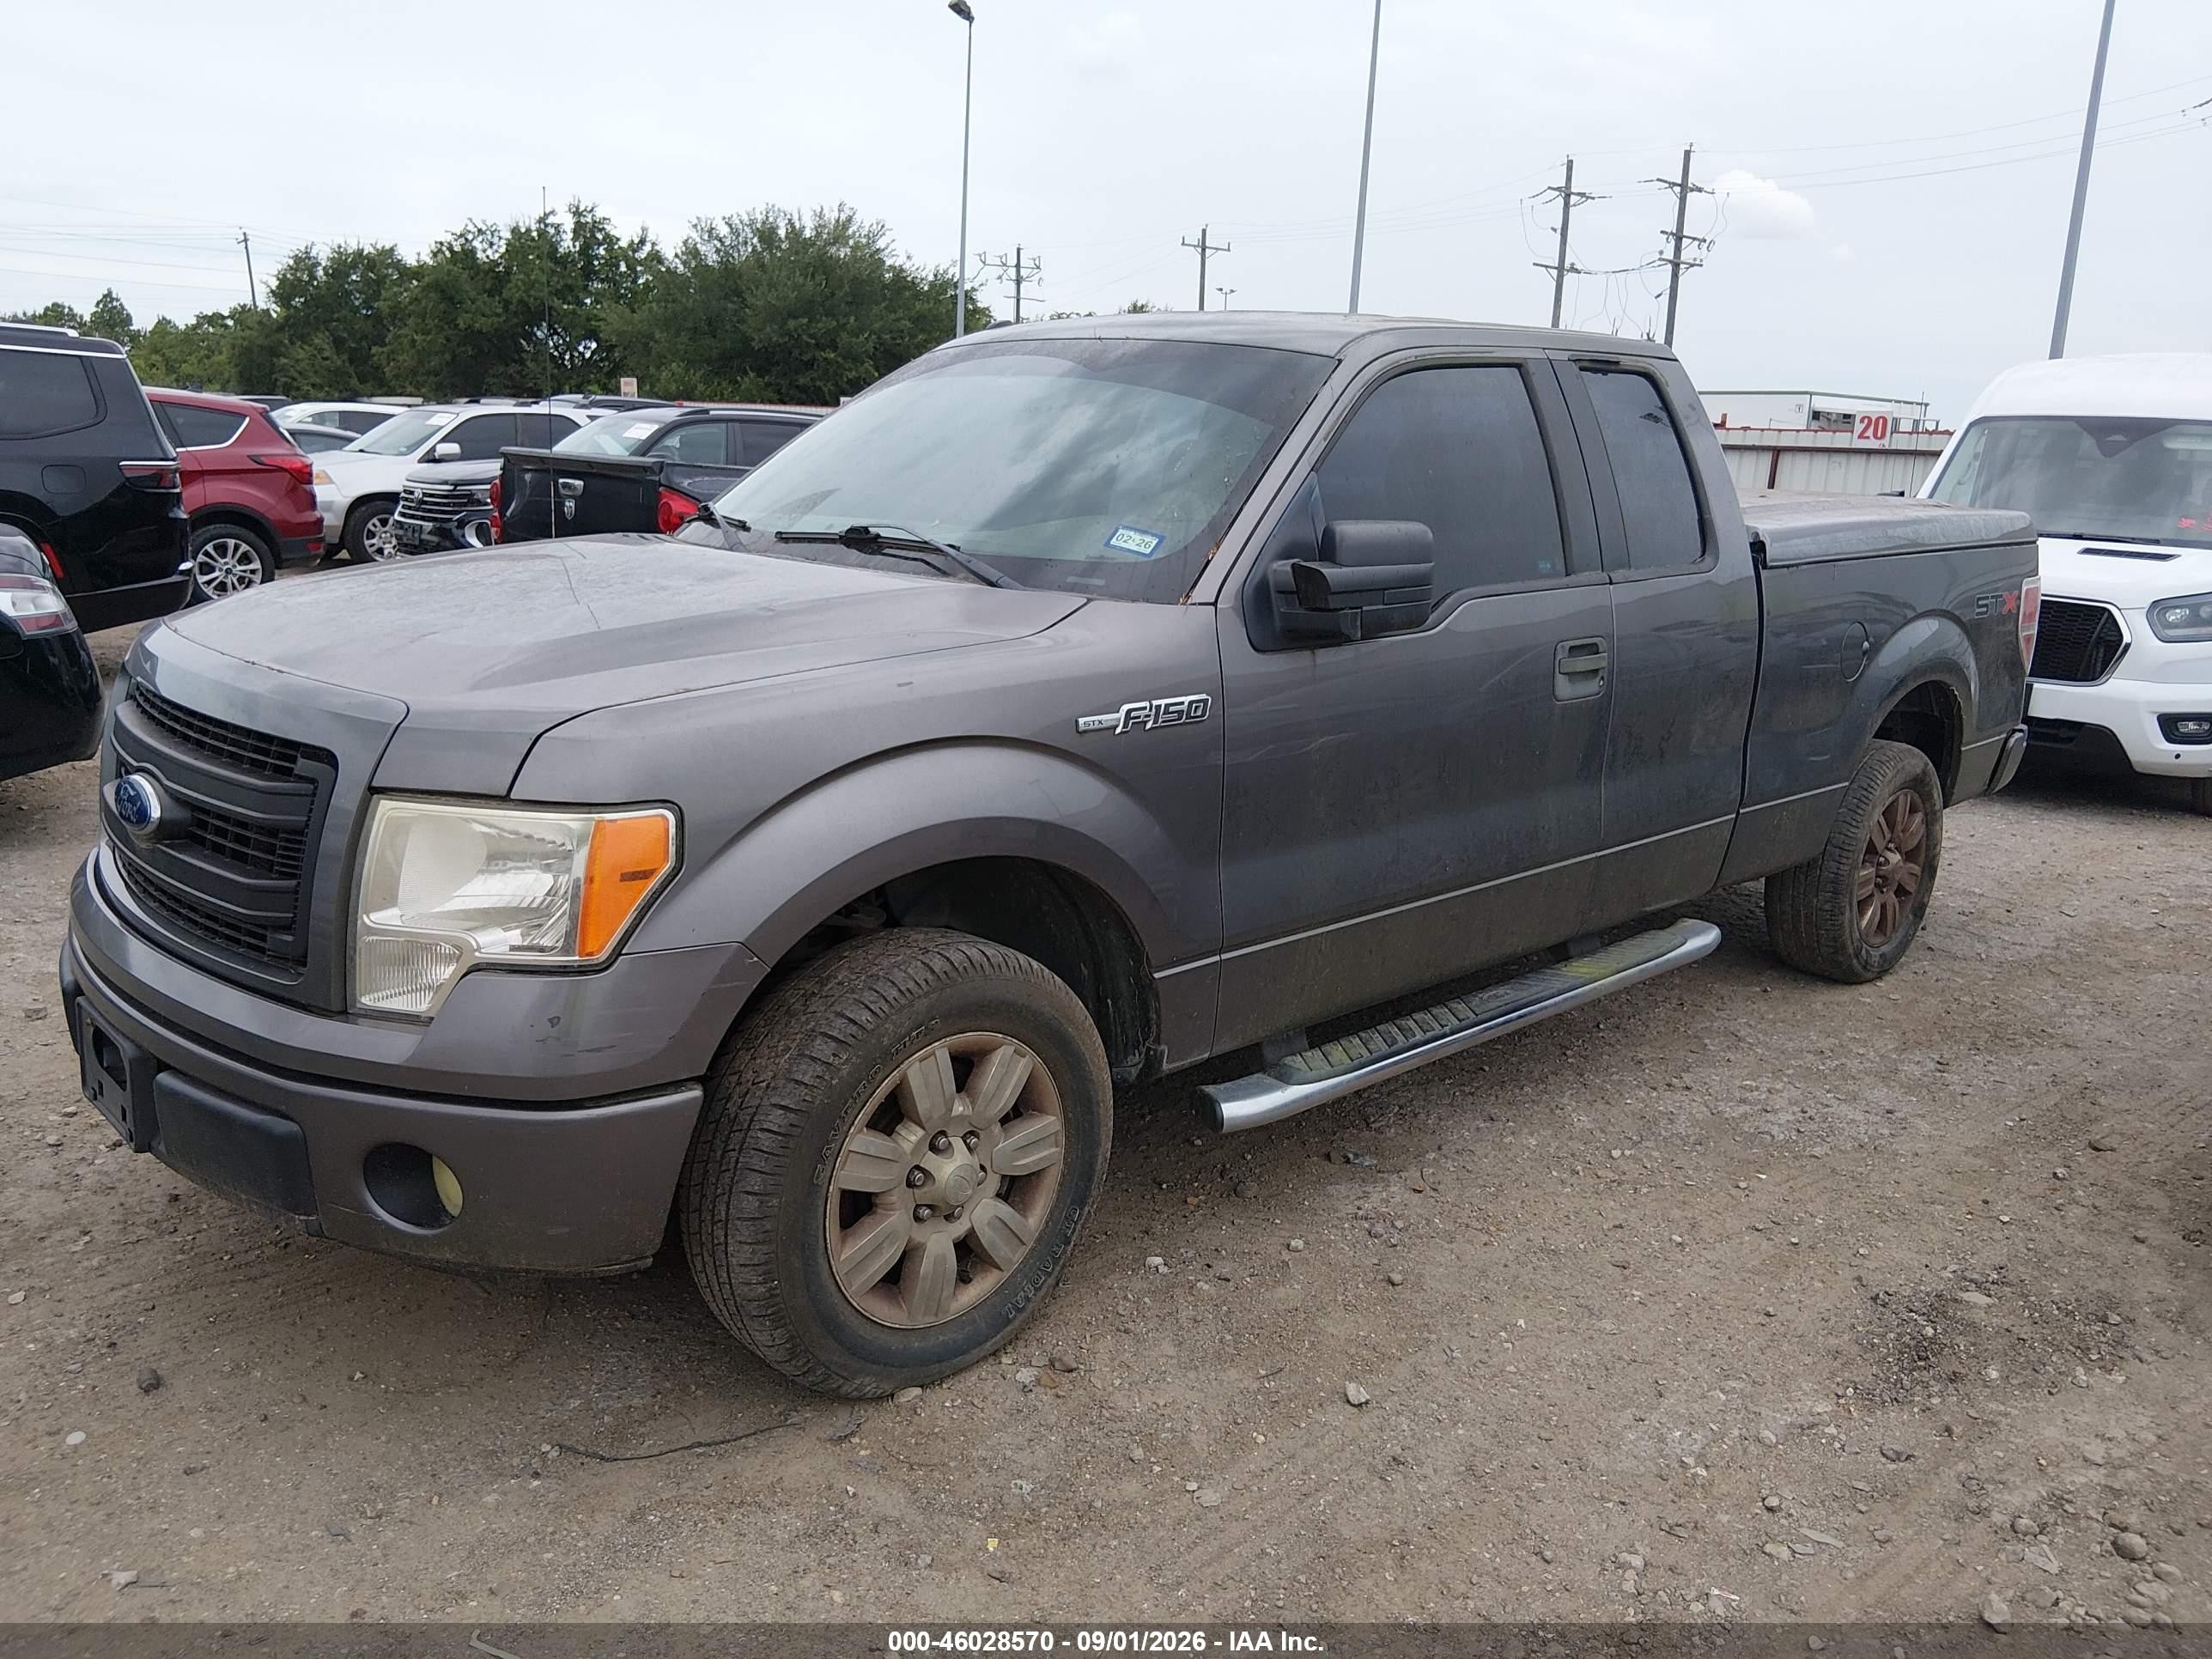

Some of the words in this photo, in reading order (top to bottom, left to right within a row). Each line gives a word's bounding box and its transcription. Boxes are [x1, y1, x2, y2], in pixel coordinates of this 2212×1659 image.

[1857, 416, 1888, 440] 20
[1115, 533, 1133, 544] 02
[1135, 538, 1153, 550] 26
[1975, 591, 2019, 618] STX
[1083, 719, 1104, 728] STX
[1115, 695, 1212, 734] F-150
[116, 782, 142, 824] Ford
[814, 1064, 882, 1186] SAVERO
[1001, 1243, 1065, 1320] RADIAL
